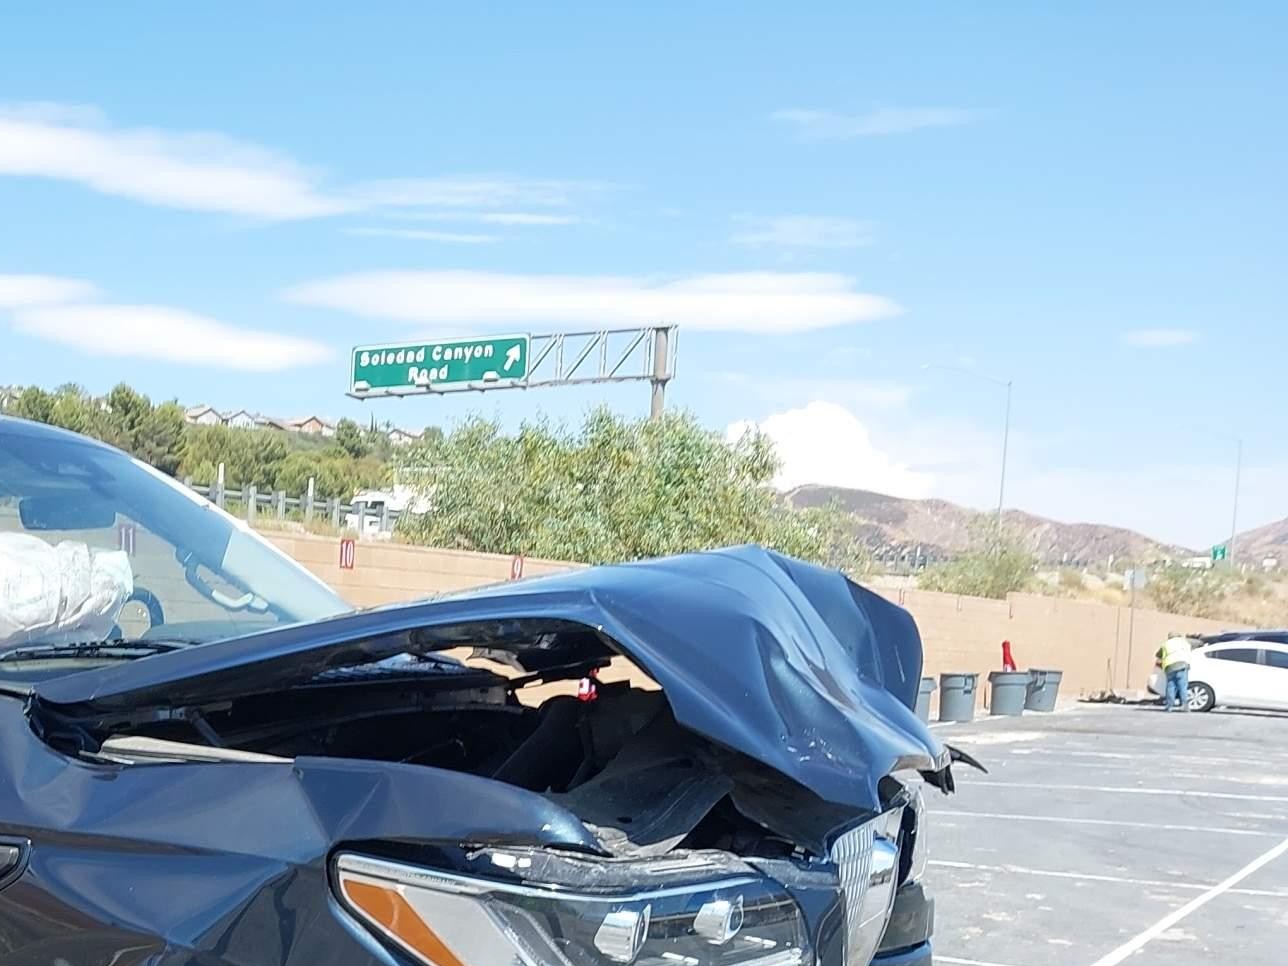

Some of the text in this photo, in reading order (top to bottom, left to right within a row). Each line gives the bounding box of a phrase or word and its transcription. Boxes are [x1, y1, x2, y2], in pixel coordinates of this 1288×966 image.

[360, 344, 494, 367] Soledad Canyon
[408, 364, 449, 382] Road
[342, 541, 354, 567] 10
